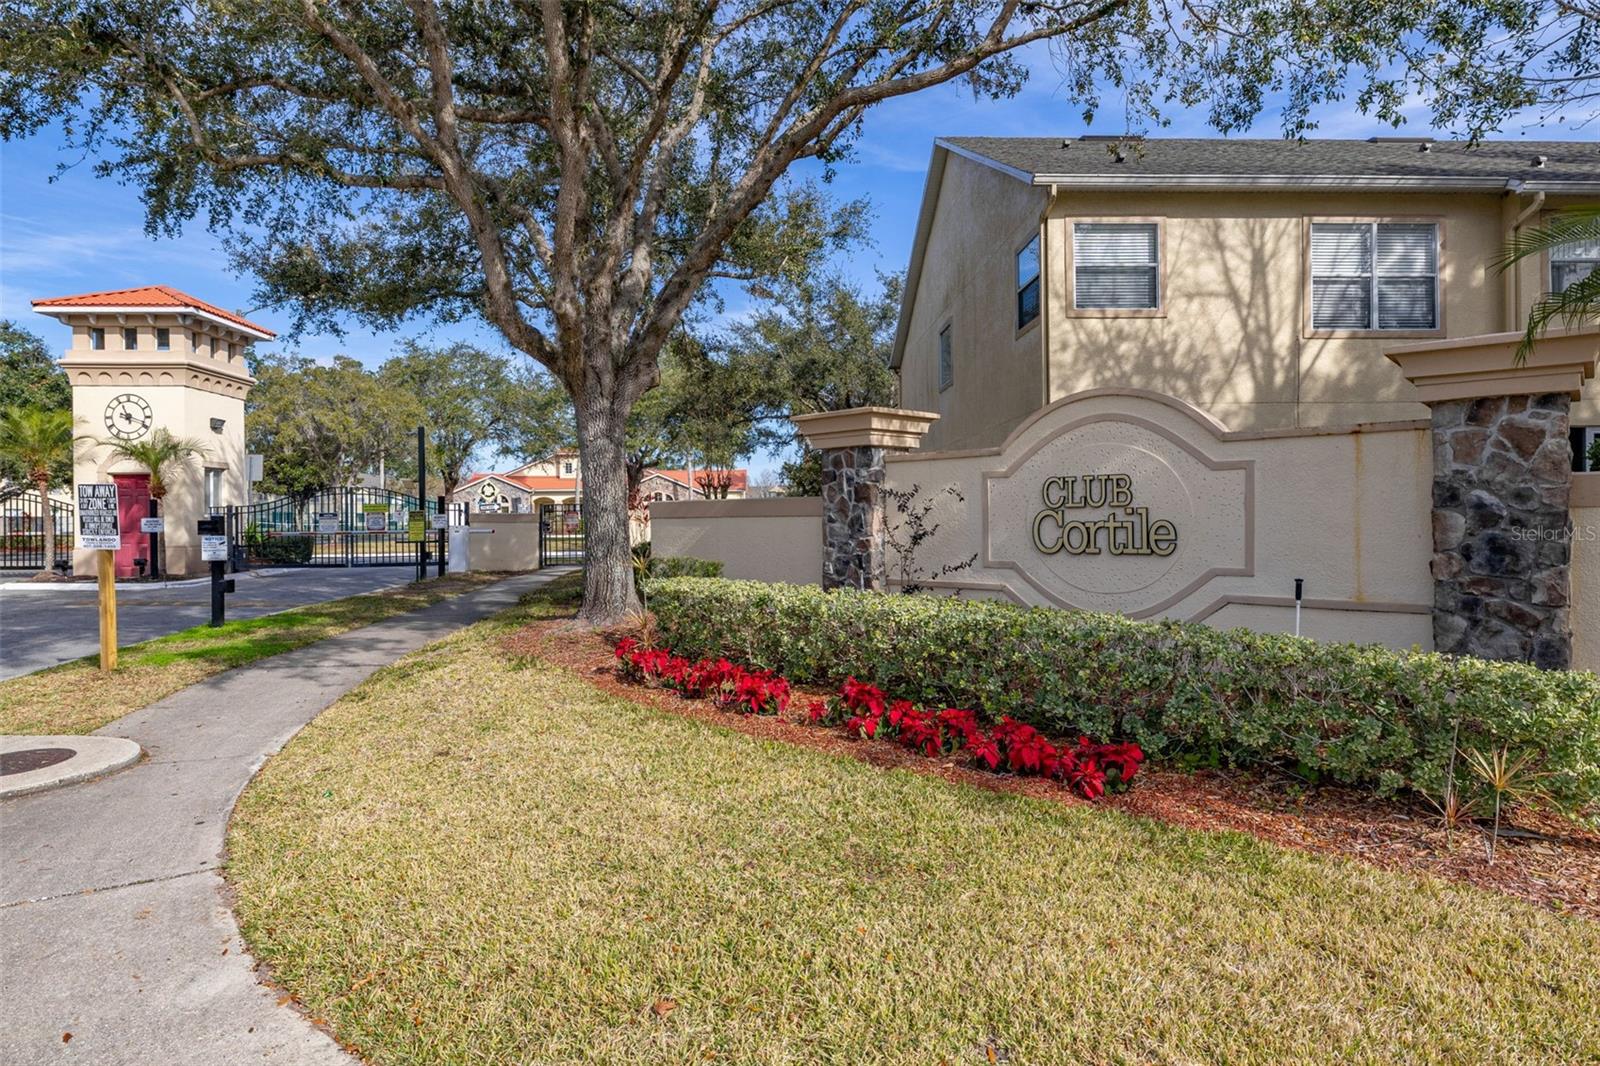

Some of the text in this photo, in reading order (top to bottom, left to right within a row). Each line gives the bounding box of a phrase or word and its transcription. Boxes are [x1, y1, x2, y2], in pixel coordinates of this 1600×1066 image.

[79, 486, 114, 497] TOW AWAY
[1042, 473, 1133, 509] CLUB
[89, 498, 107, 509] ZONE
[1032, 506, 1178, 556] Cortile
